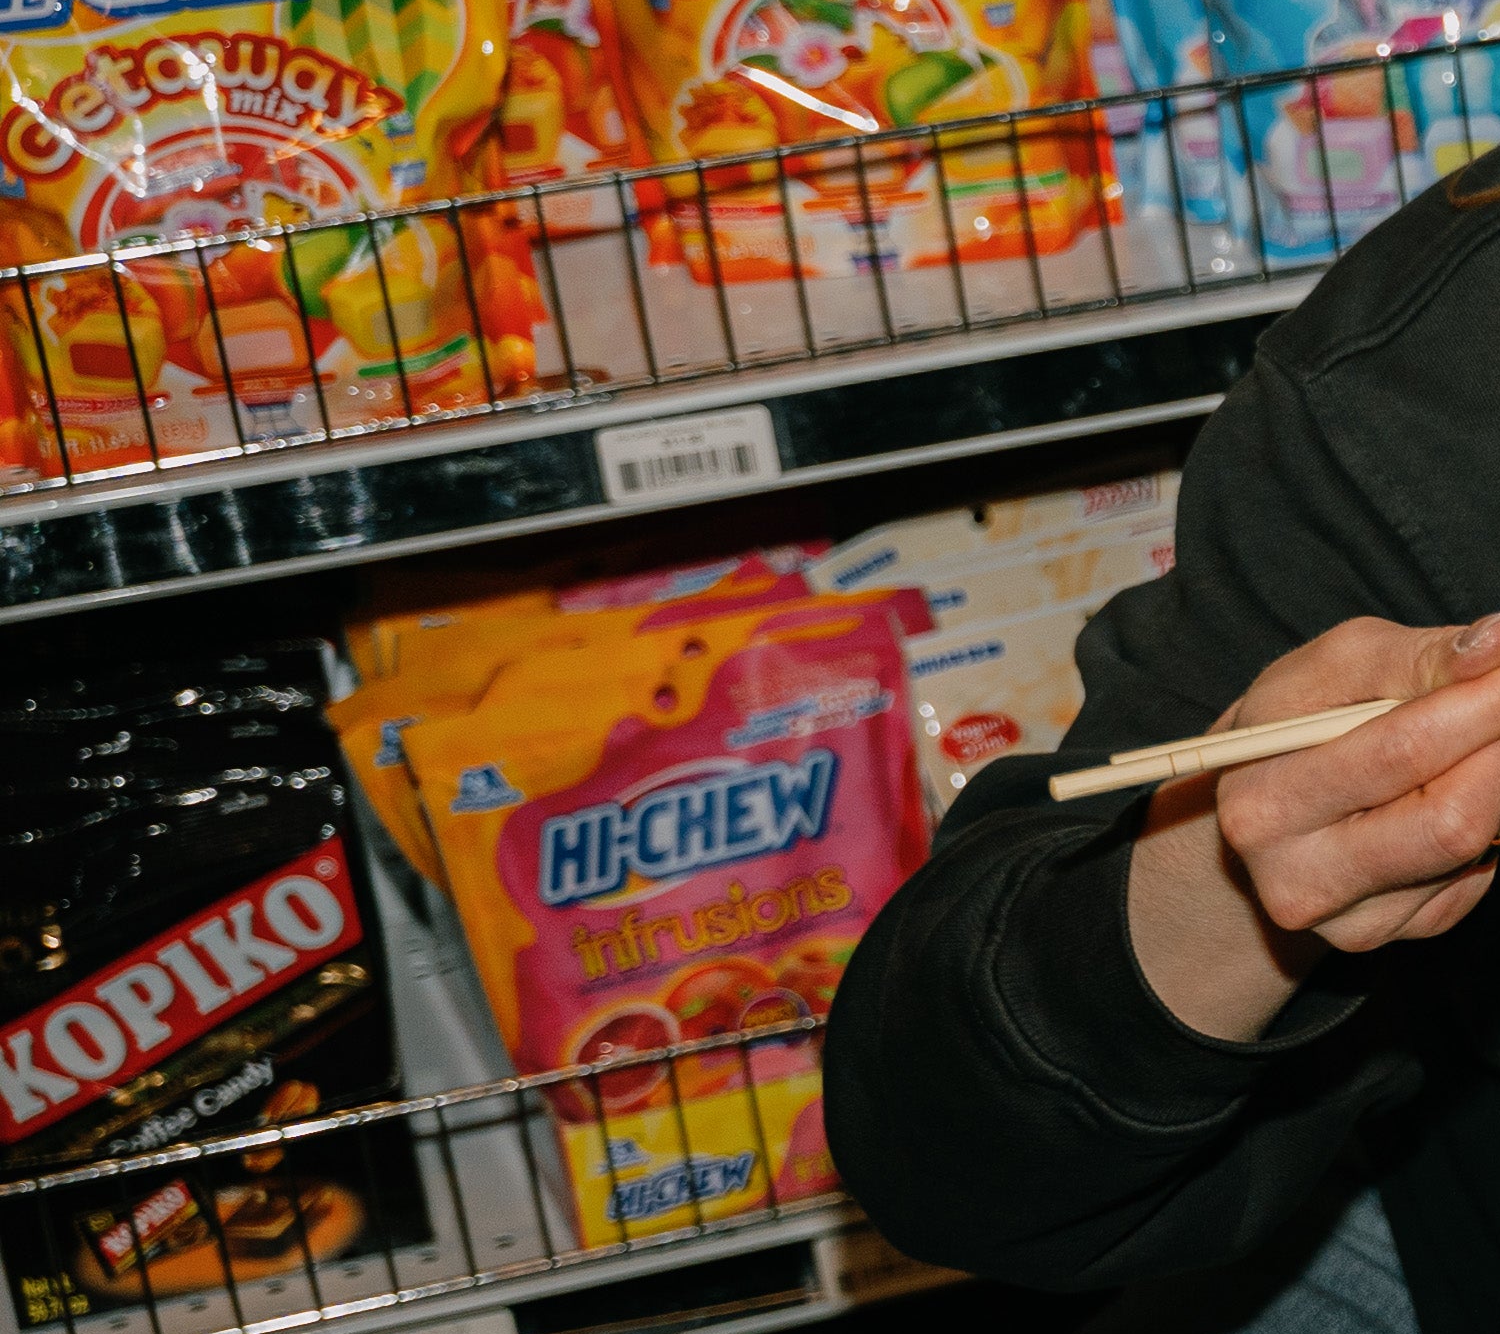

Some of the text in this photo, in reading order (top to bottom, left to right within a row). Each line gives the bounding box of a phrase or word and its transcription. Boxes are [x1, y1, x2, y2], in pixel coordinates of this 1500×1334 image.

[1, 33, 406, 180] Getaway
[229, 89, 304, 126] mix
[539, 749, 840, 909] HI-CHEW
[573, 867, 854, 979] infrusions
[0, 873, 346, 1125] KOPIKO
